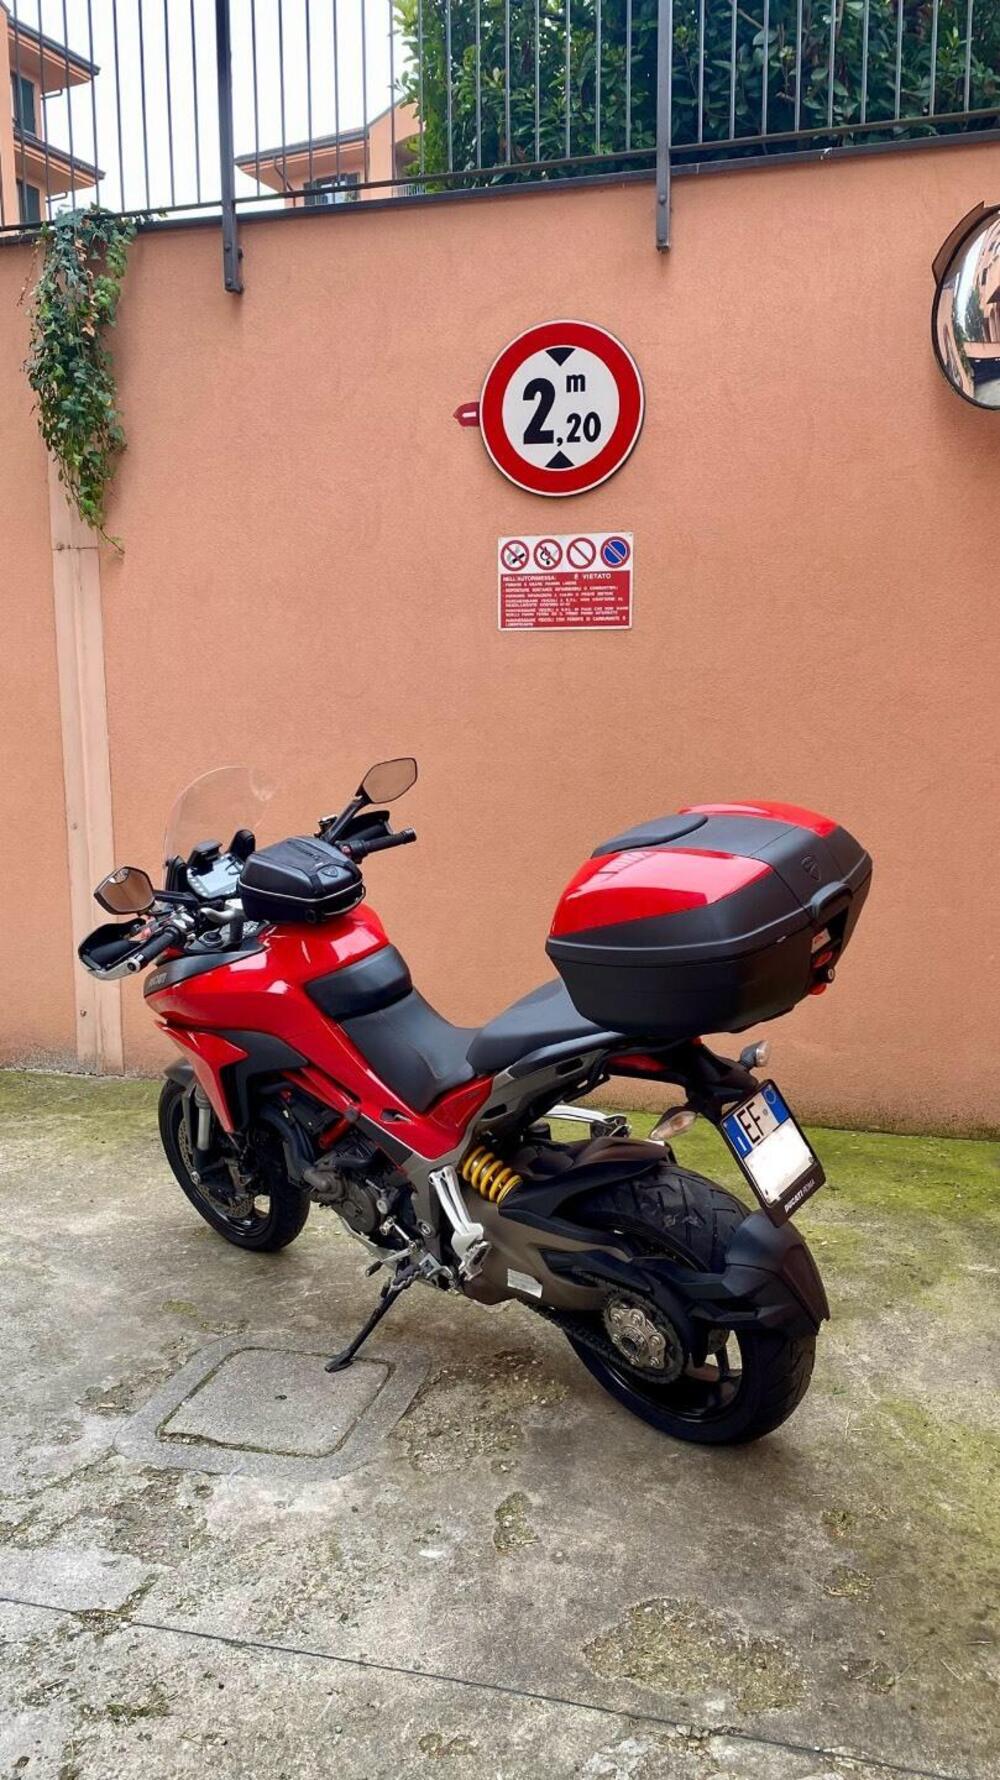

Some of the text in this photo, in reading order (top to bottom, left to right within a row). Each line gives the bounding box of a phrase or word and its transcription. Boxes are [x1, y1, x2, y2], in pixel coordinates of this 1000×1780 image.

[565, 373, 586, 393] m
[583, 572, 612, 580] VIETATO
[736, 1101, 764, 1144] EF
